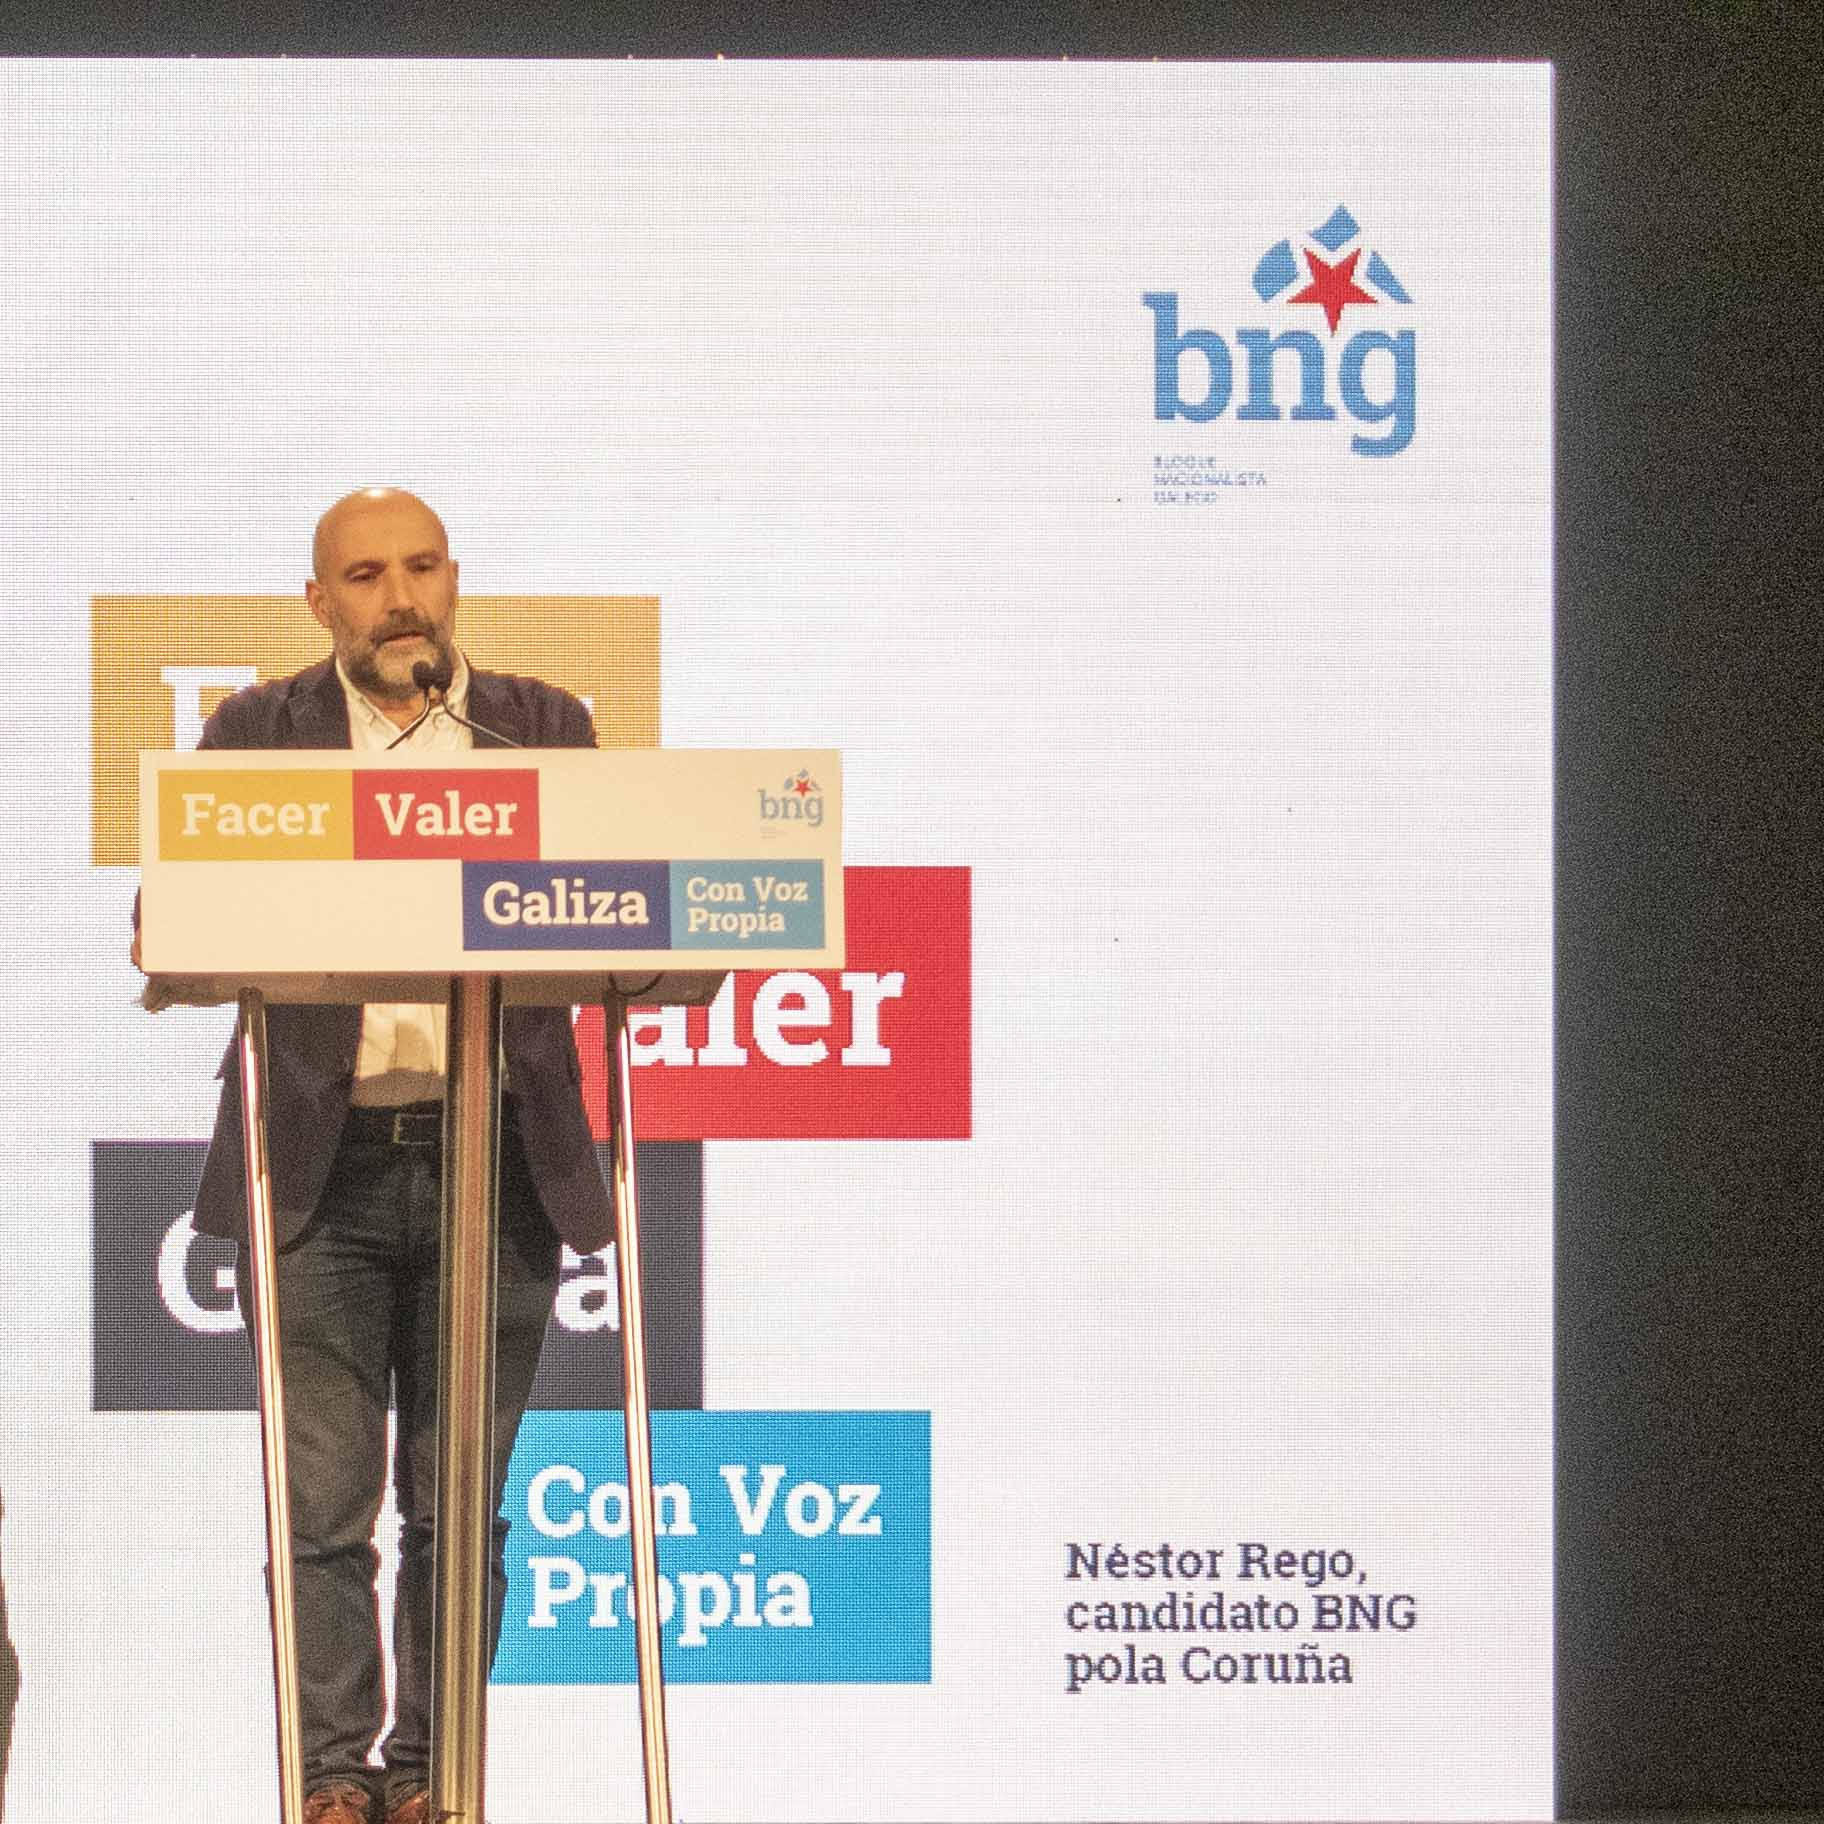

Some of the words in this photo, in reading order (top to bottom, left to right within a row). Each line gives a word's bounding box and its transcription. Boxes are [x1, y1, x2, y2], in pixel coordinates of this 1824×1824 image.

[1143, 291, 1417, 457] bng
[181, 792, 330, 836] Facer
[374, 790, 518, 836] Valer
[757, 788, 824, 828] bng
[483, 878, 649, 926] Galiza
[687, 876, 746, 903] Con
[754, 877, 809, 903] Voz
[687, 907, 786, 938] Propia
[571, 970, 905, 1067] aler
[527, 1464, 697, 1538] Con
[719, 1463, 883, 1538] Voz
[1064, 1542, 1224, 1580] Néstor
[1238, 1542, 1367, 1587] Rego,
[1065, 1592, 1299, 1632] candidato
[1312, 1594, 1417, 1632] BNG
[1064, 1644, 1167, 1694] pola
[1181, 1643, 1353, 1684] Coruña
